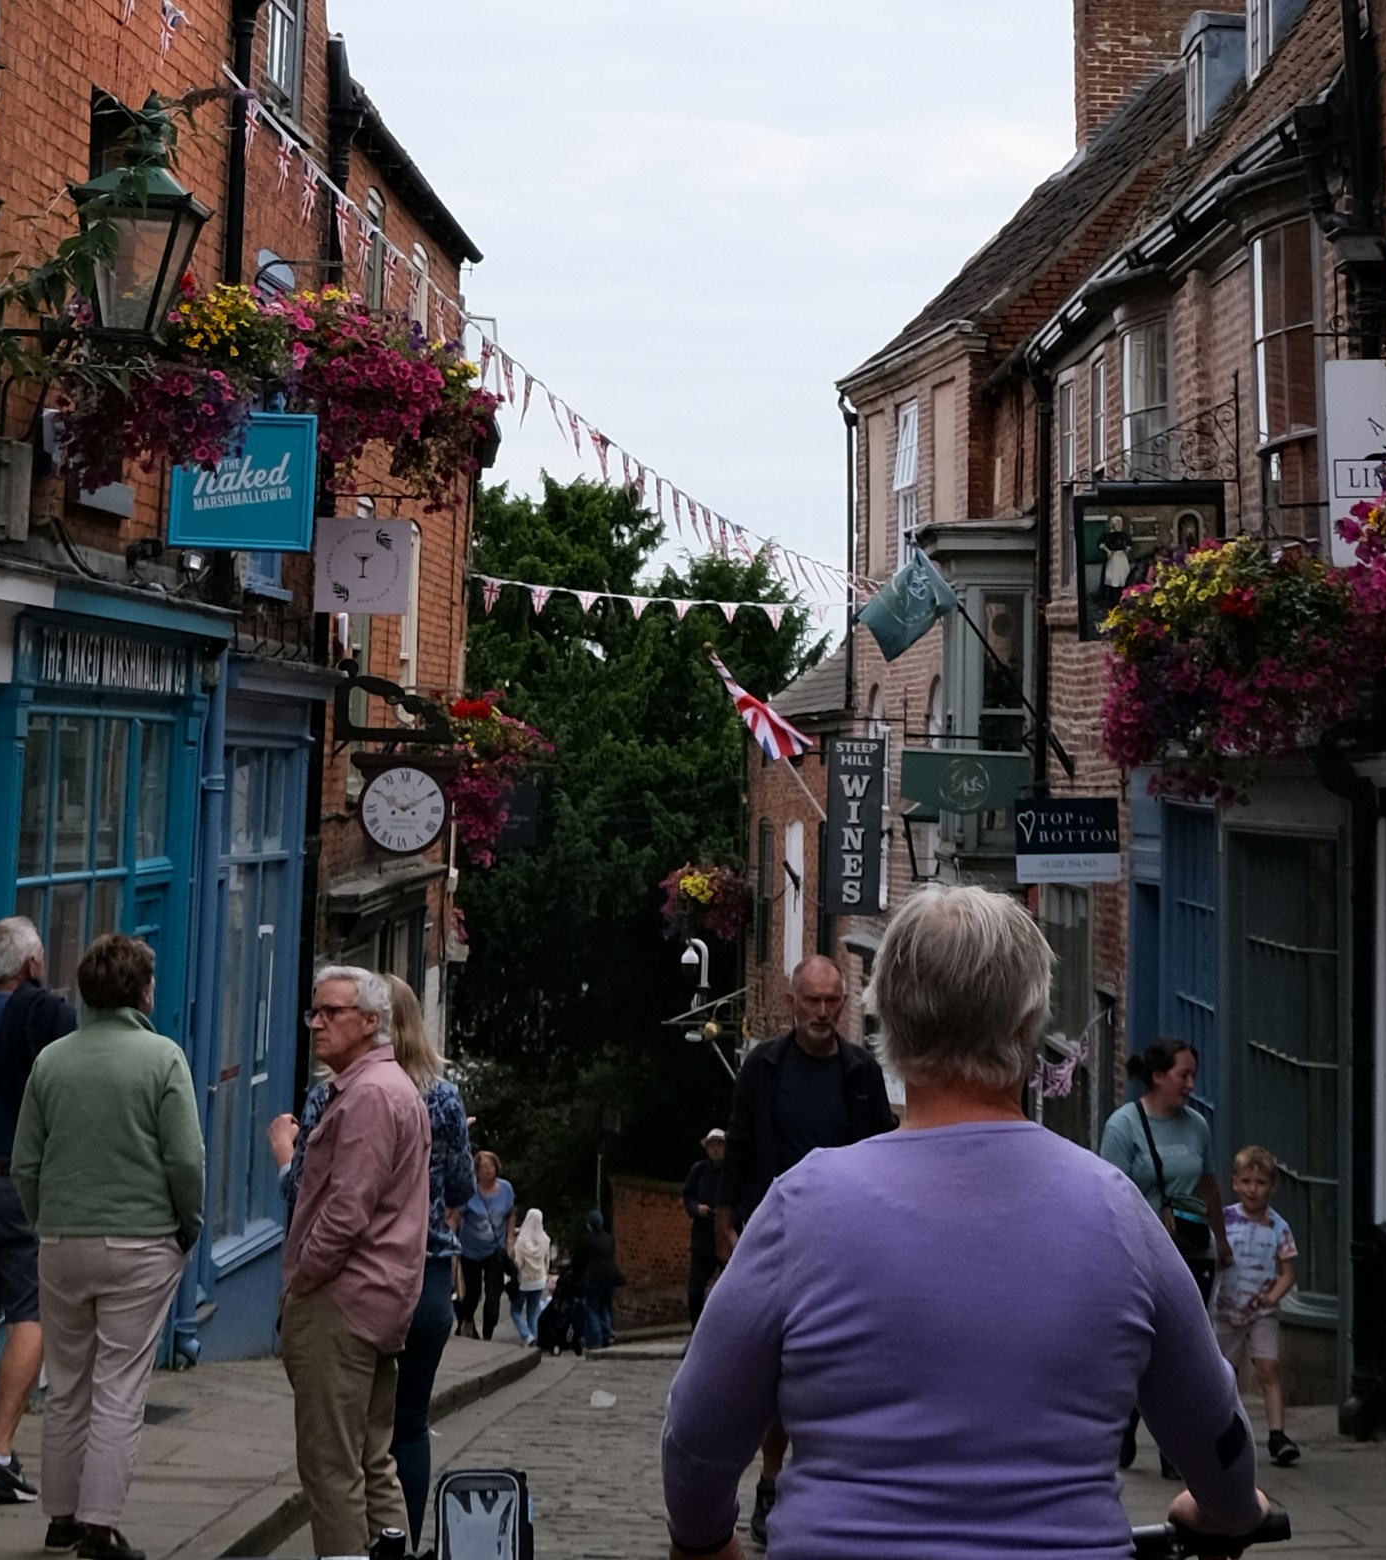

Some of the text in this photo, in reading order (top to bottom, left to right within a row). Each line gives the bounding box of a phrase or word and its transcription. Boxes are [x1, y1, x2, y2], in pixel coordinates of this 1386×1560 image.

[1367, 417, 1385, 436] A
[224, 458, 242, 470] THE
[42, 626, 62, 681] THE
[65, 631, 101, 686] NAKED
[101, 636, 174, 696] MARSHMALLOW
[835, 741, 879, 753] STEEP
[840, 755, 872, 767] HILL
[1036, 811, 1095, 826] TOP to
[839, 774, 871, 904] WINES
[1038, 829, 1118, 843] BOTTOM
